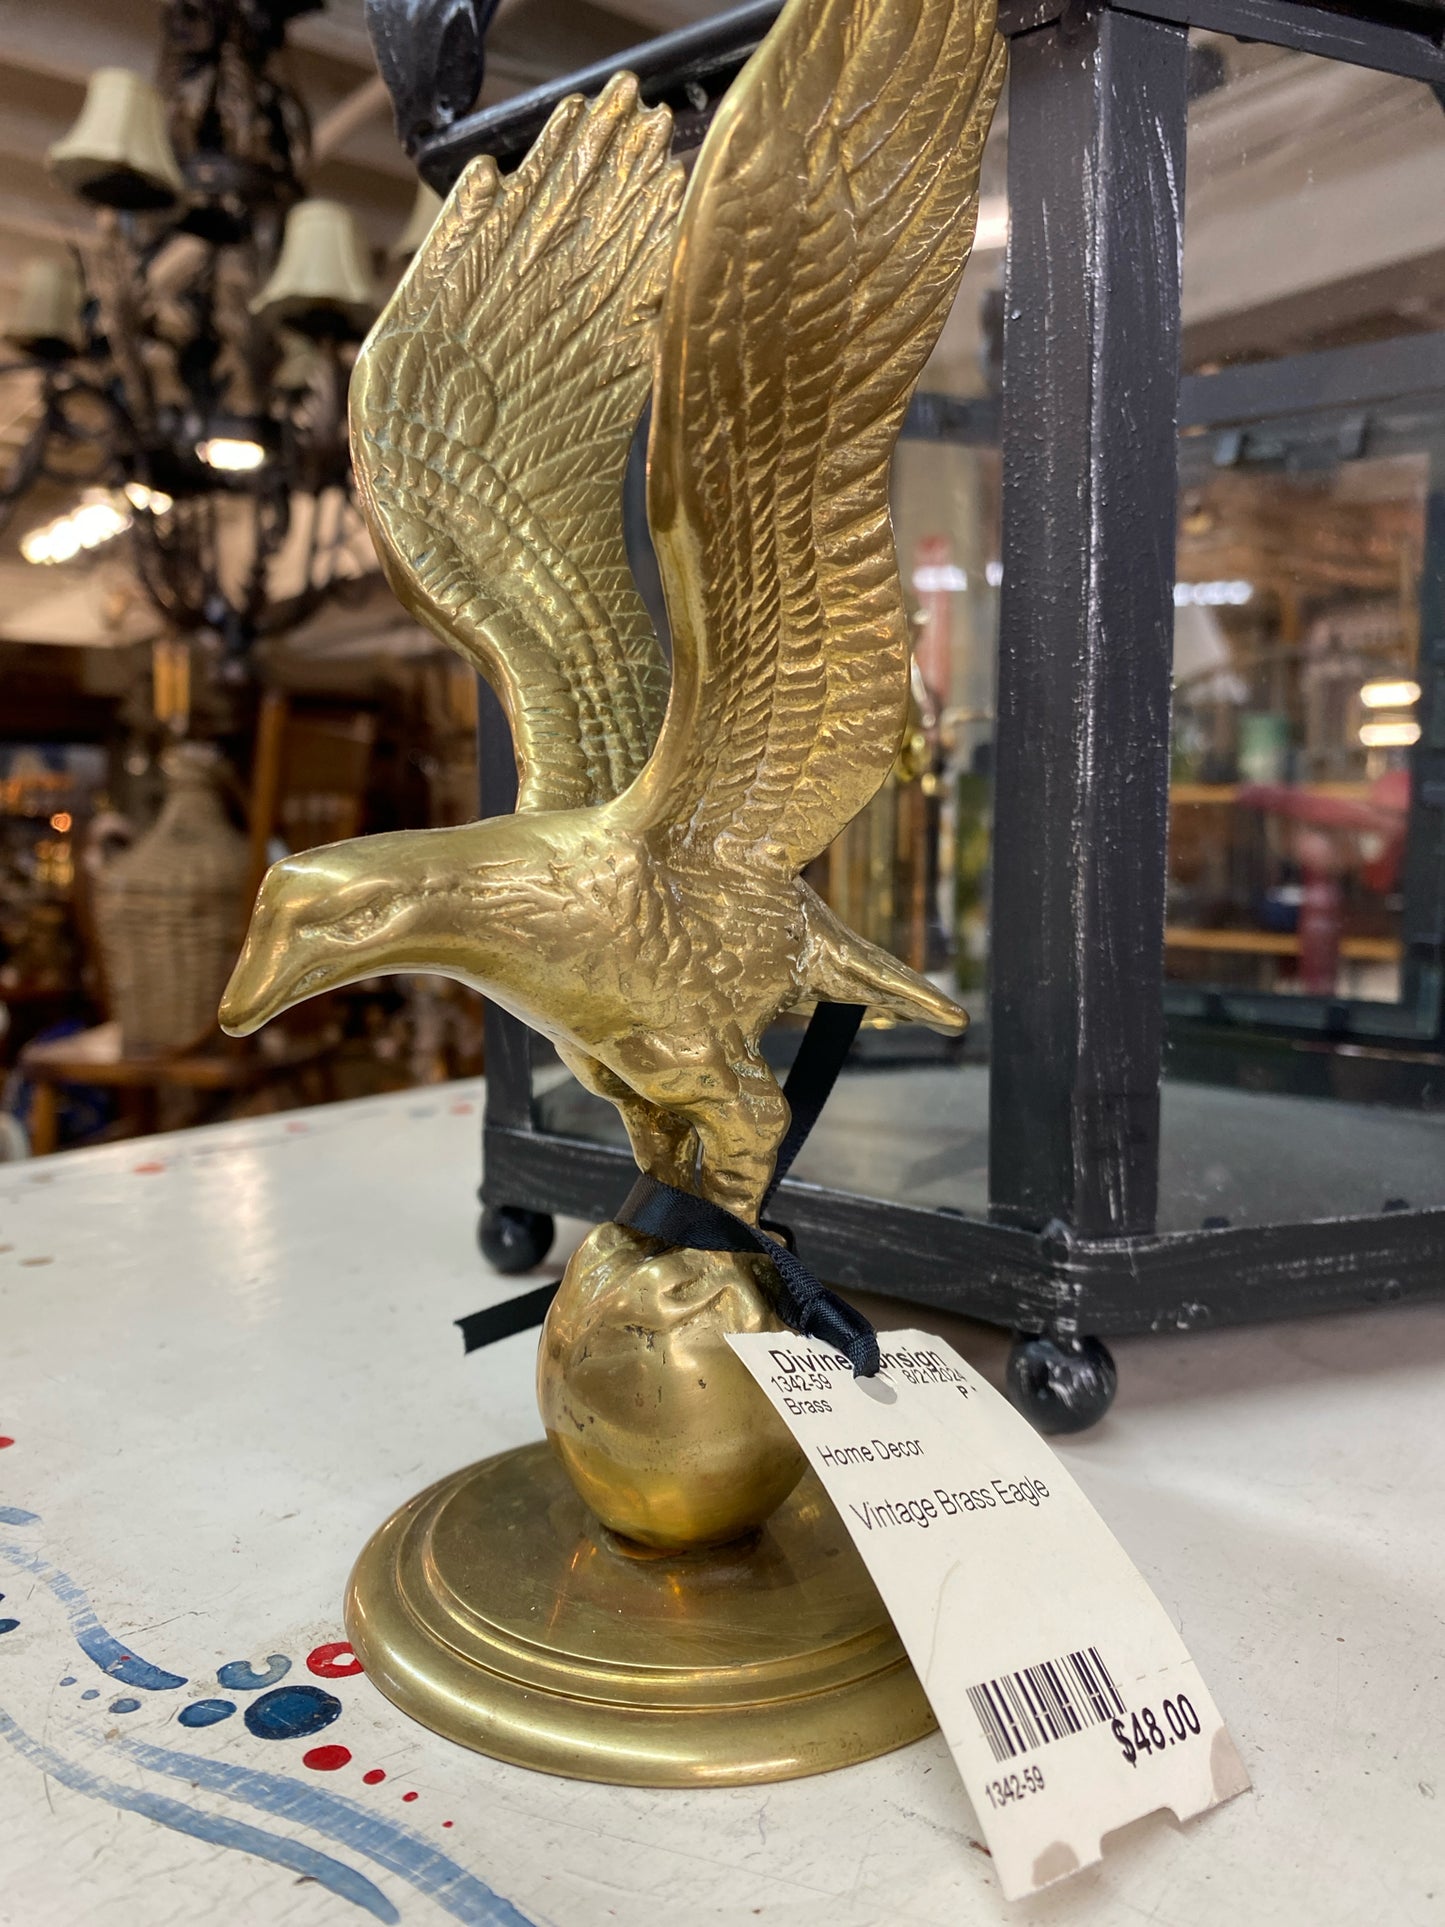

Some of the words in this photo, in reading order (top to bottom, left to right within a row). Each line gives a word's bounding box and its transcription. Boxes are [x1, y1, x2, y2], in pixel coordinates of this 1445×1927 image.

[768, 1348, 853, 1374] Divine
[880, 1346, 947, 1373] nsign
[771, 1373, 833, 1393] 1342-59
[783, 1397, 833, 1416] Brass
[816, 1445, 874, 1467] Home
[871, 1439, 924, 1460] Decor
[849, 1498, 938, 1529] Vintage
[934, 1489, 996, 1516] Brass
[991, 1475, 1050, 1507] Eagle
[1111, 1693, 1201, 1769] $48.00
[985, 1765, 1045, 1809] 1342-59
